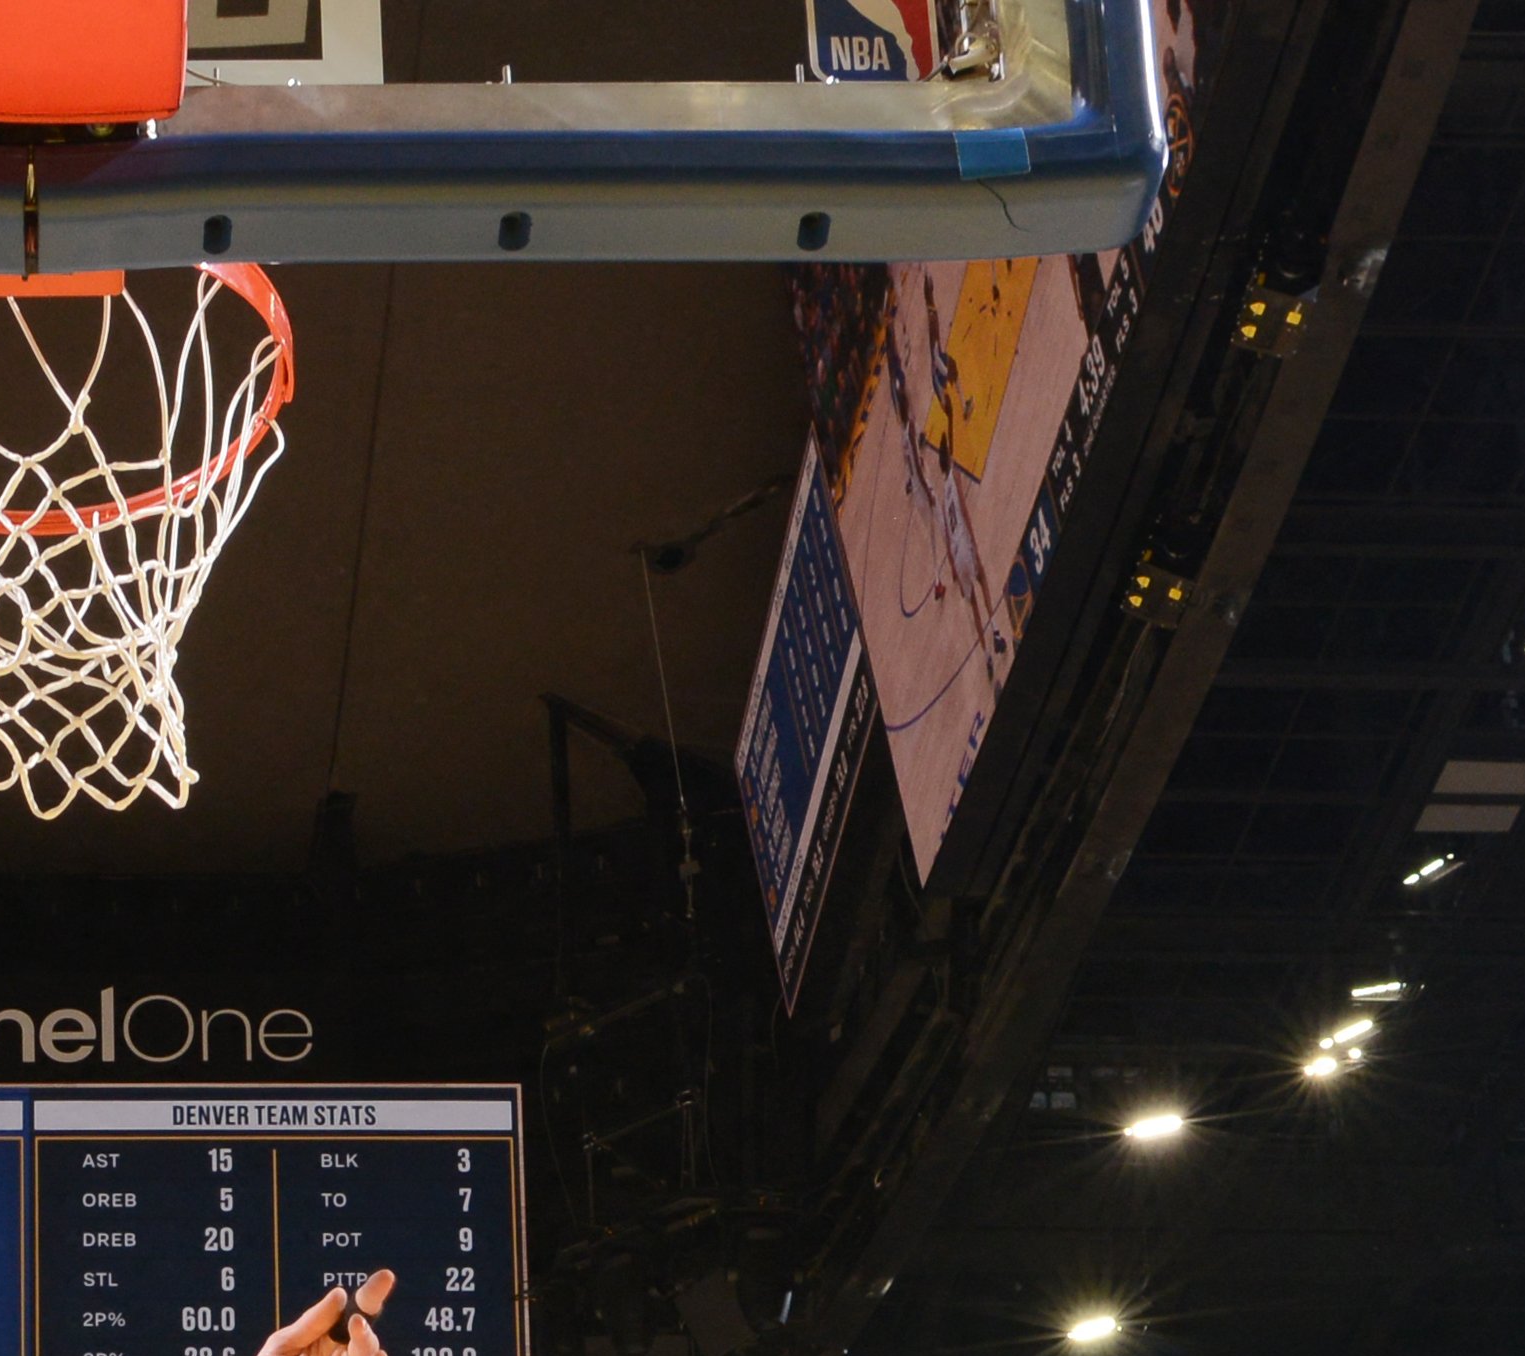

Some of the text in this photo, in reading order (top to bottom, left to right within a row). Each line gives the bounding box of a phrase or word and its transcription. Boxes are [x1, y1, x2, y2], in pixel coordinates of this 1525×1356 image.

[831, 36, 890, 71] NBA
[172, 1105, 377, 1126] DENVER TEAM STATS
[82, 1148, 234, 1174] AST 15
[320, 1148, 471, 1174] BLK 3
[82, 1188, 234, 1214] OREB 5
[321, 1188, 472, 1214] TO 7
[82, 1227, 235, 1253] DREB 20
[322, 1227, 473, 1253] POT 9
[83, 1266, 235, 1293] STL 6
[445, 1266, 475, 1293] 22
[82, 1306, 236, 1333] 2P% 60.0
[424, 1306, 477, 1333] 48.7
